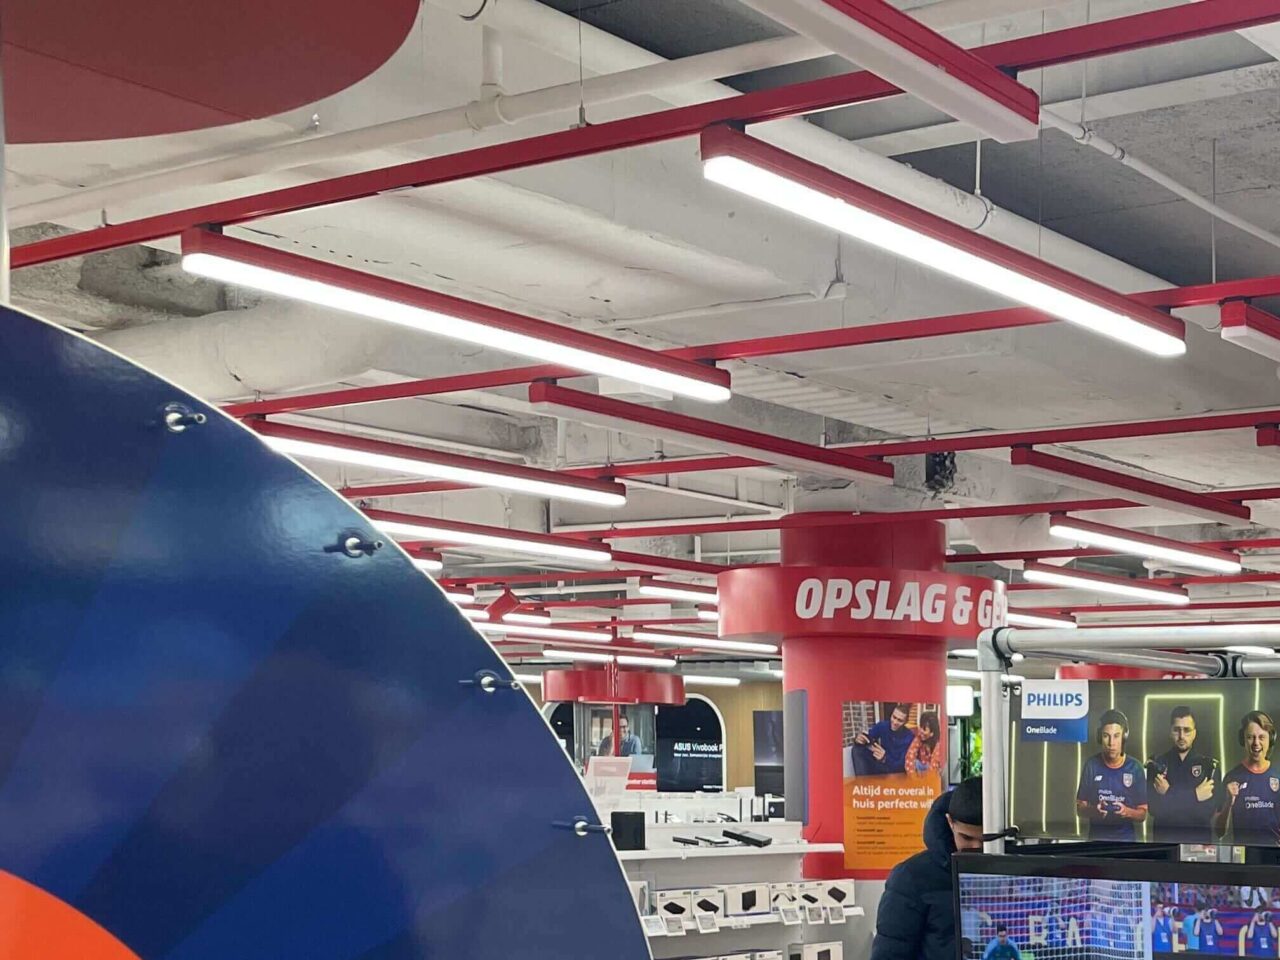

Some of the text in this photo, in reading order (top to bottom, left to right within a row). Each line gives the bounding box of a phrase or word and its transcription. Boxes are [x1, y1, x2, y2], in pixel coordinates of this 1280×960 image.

[795, 578, 947, 623] OPSLAG
[952, 586, 973, 625] &
[1027, 693, 1083, 706] PHILIPS
[1026, 726, 1057, 735] OneBlade
[674, 742, 691, 751] ASUS
[852, 785, 934, 797] Altijd en overal in
[852, 798, 875, 809] huis
[878, 798, 918, 811] perfecte
